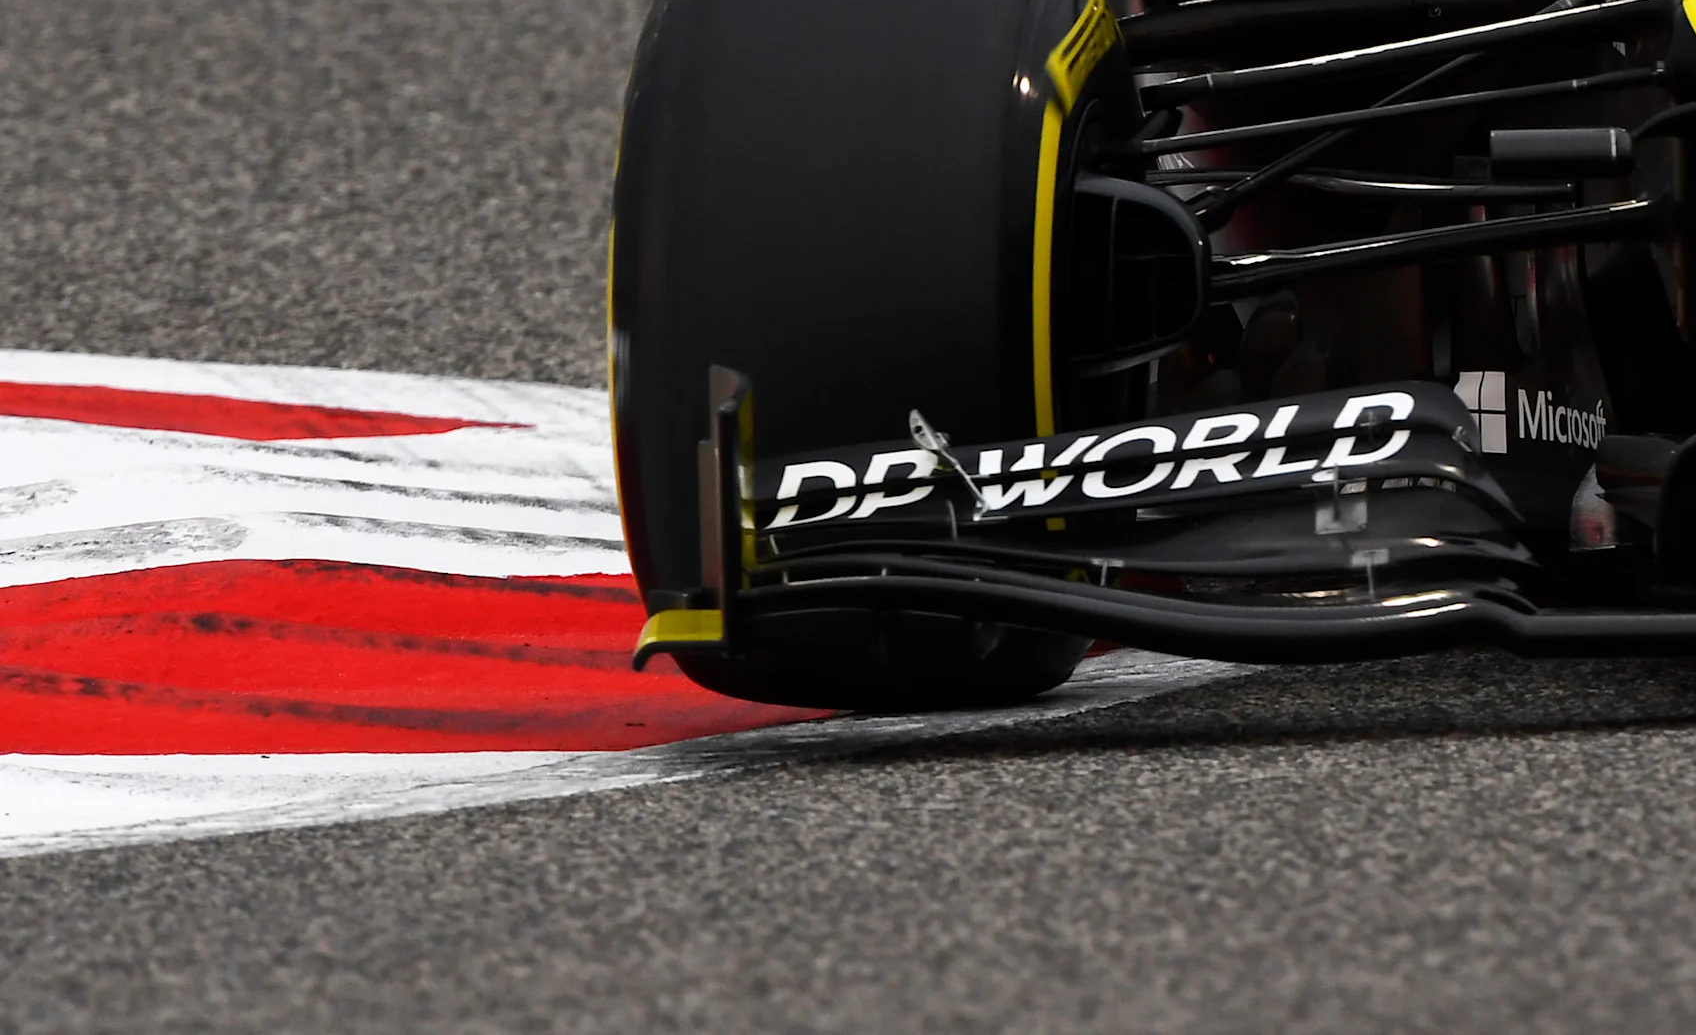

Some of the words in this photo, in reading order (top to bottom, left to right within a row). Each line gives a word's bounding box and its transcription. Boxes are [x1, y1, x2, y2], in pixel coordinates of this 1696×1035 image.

[765, 449, 939, 529] DP
[978, 391, 1416, 511] WORLD
[1517, 388, 1607, 451] Microsoft
